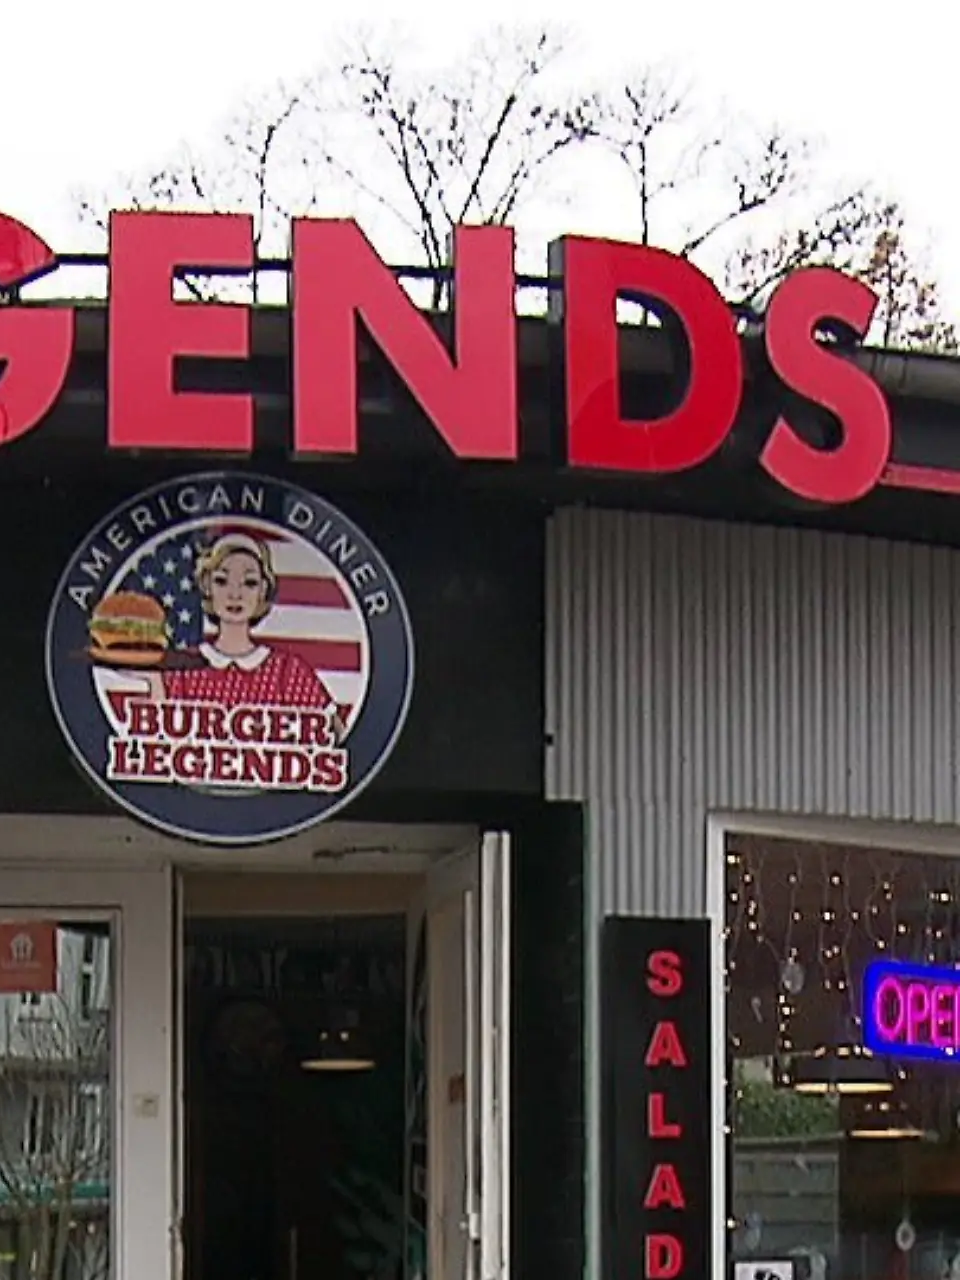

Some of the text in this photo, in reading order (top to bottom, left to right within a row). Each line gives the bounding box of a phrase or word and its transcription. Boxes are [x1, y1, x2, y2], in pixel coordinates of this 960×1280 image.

[68, 484, 390, 618] AMERICAN DINER
[127, 701, 331, 746] BURGER
[112, 741, 345, 787] LEGENDS
